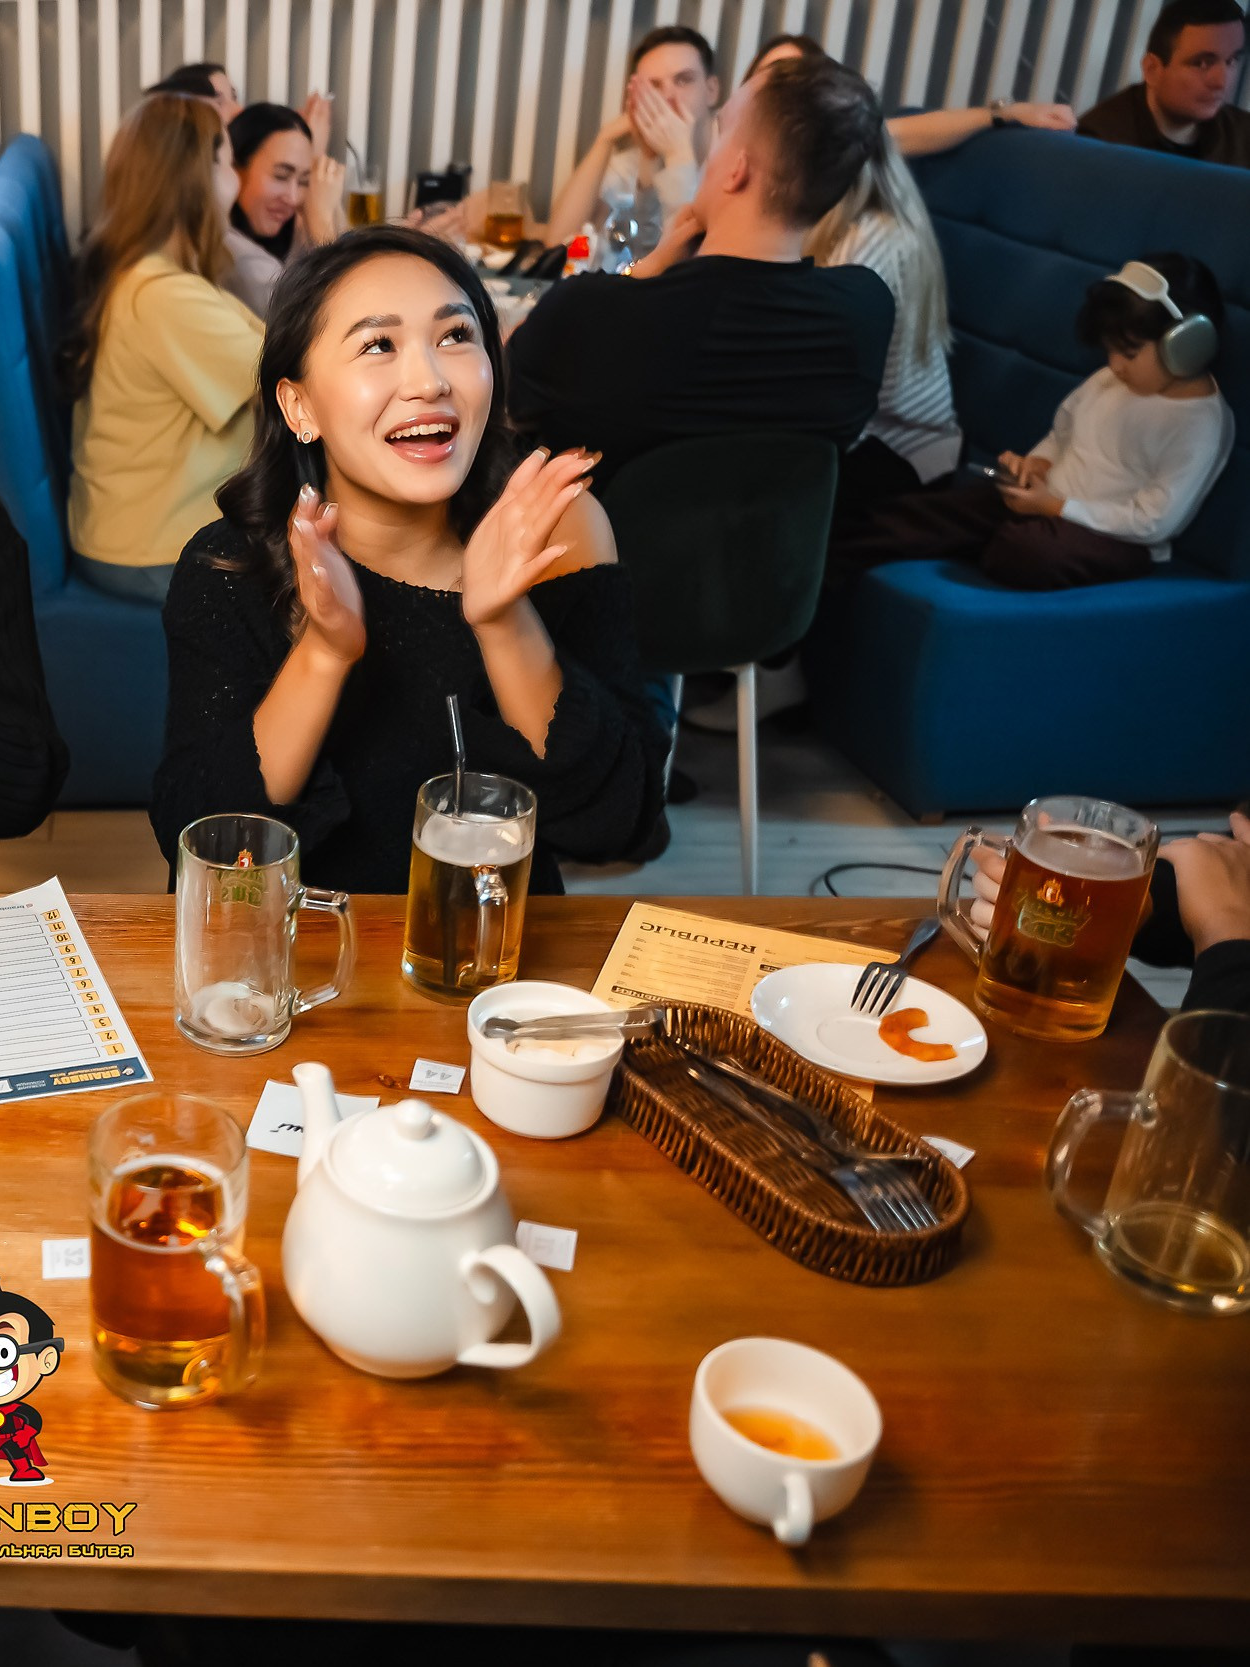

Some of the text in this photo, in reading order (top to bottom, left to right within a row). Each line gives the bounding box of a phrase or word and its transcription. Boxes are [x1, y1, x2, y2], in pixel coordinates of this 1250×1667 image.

[48, 911, 58, 920] 12
[56, 934, 68, 942] 10
[639, 922, 757, 954] REPUBLIC
[69, 957, 76, 965] 8
[81, 981, 87, 989] 6
[86, 993, 94, 1002] 5
[93, 1006, 100, 1014] 4
[99, 1018, 106, 1026] 3
[105, 1032, 112, 1040] 2
[112, 1045, 119, 1054] 1
